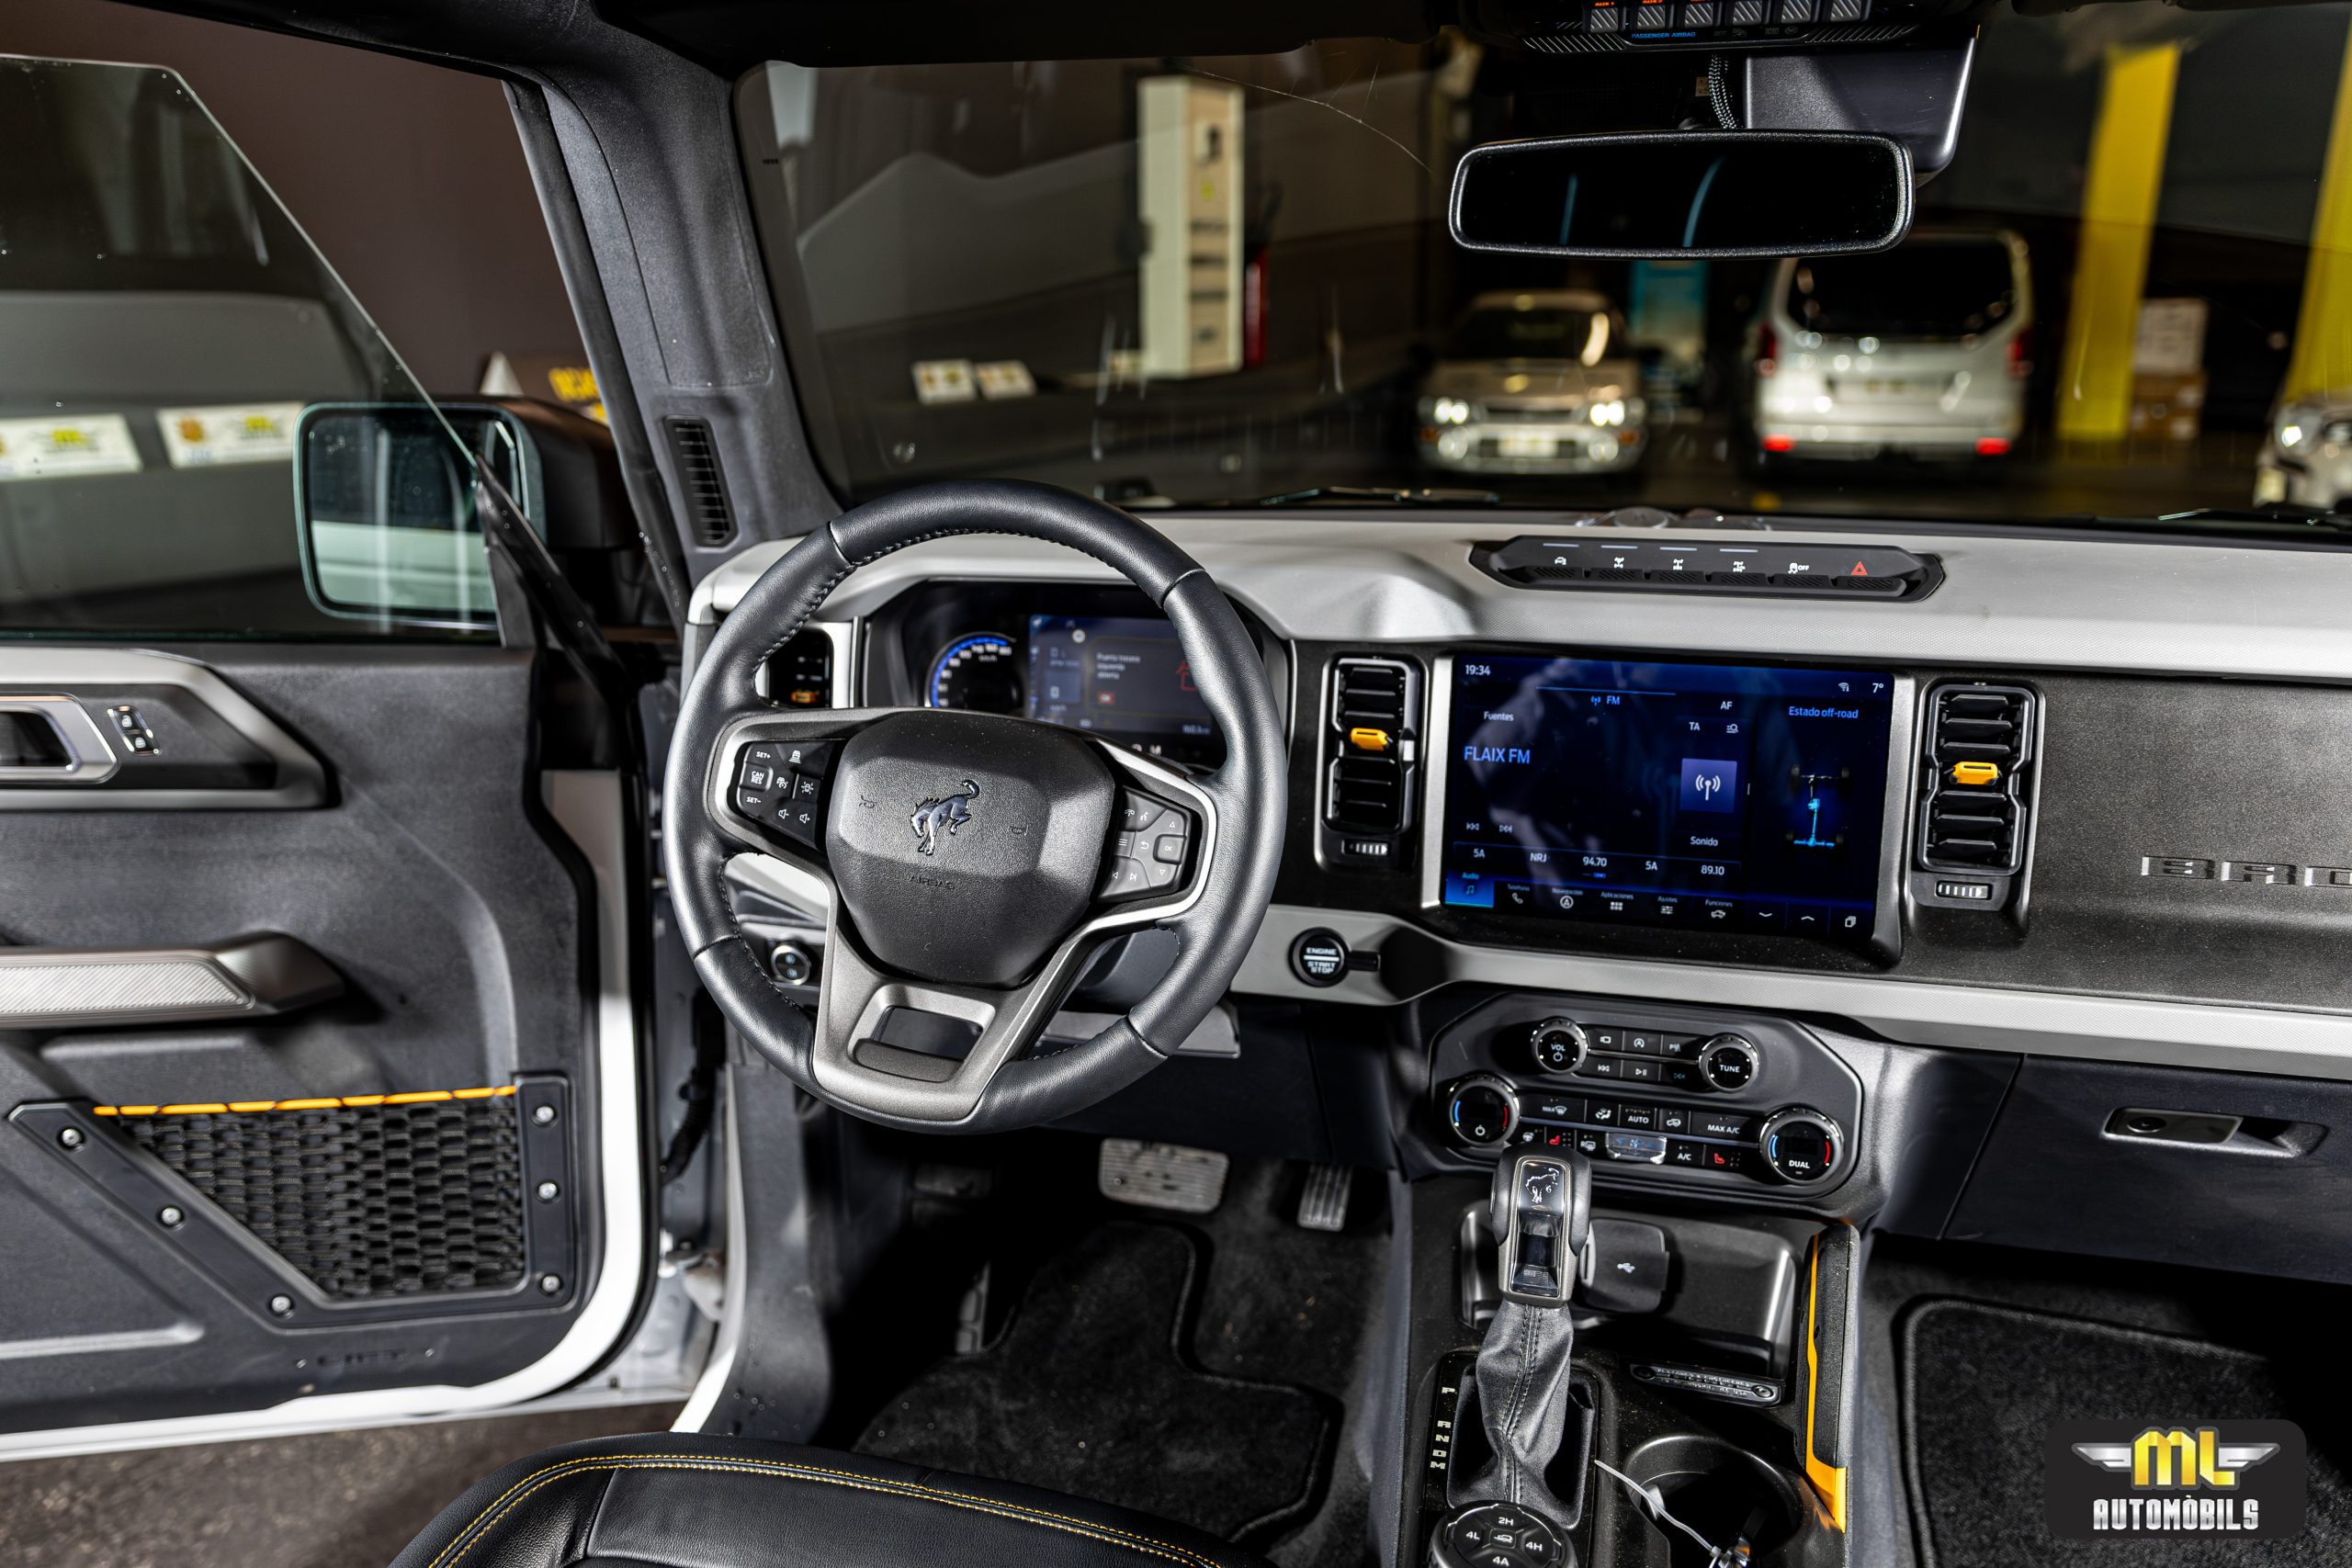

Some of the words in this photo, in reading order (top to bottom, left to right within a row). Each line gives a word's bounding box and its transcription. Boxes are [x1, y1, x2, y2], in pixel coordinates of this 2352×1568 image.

[1465, 664, 1491, 676] 19:34
[1872, 682, 1883, 693] 7°
[1606, 695, 1621, 705] FM
[1720, 701, 1733, 710] AF
[1483, 710, 1514, 721] Fuentes
[1789, 705, 1820, 717] Estado
[1821, 707, 1859, 719] off-road
[1689, 721, 1701, 731] TA
[1464, 745, 1506, 762] FLAIX
[1508, 748, 1531, 764] FM
[1690, 836, 1718, 846] Sonido
[1164, 844, 1173, 852] OK
[1530, 852, 1547, 863] NRJ
[1582, 856, 1608, 867] 94.70
[1701, 864, 1725, 875] 89.10
[1462, 872, 1480, 880] Audio
[1306, 947, 1336, 955] ENGINE
[1551, 1043, 1566, 1052] VOL
[1719, 1064, 1740, 1073] TUNE
[1627, 1114, 1649, 1124] AUTO
[1707, 1123, 1725, 1133] MAX
[1726, 1124, 1740, 1134] A/C
[1677, 1152, 1691, 1162] A/C
[1788, 1159, 1811, 1169] DUAL
[1435, 1434, 1450, 1442] N
[1430, 1461, 1446, 1470] M
[1498, 1517, 1514, 1526] 2H
[1465, 1530, 1480, 1540] 4L
[1525, 1541, 1543, 1551] 4H
[1492, 1555, 1510, 1566] 4A
